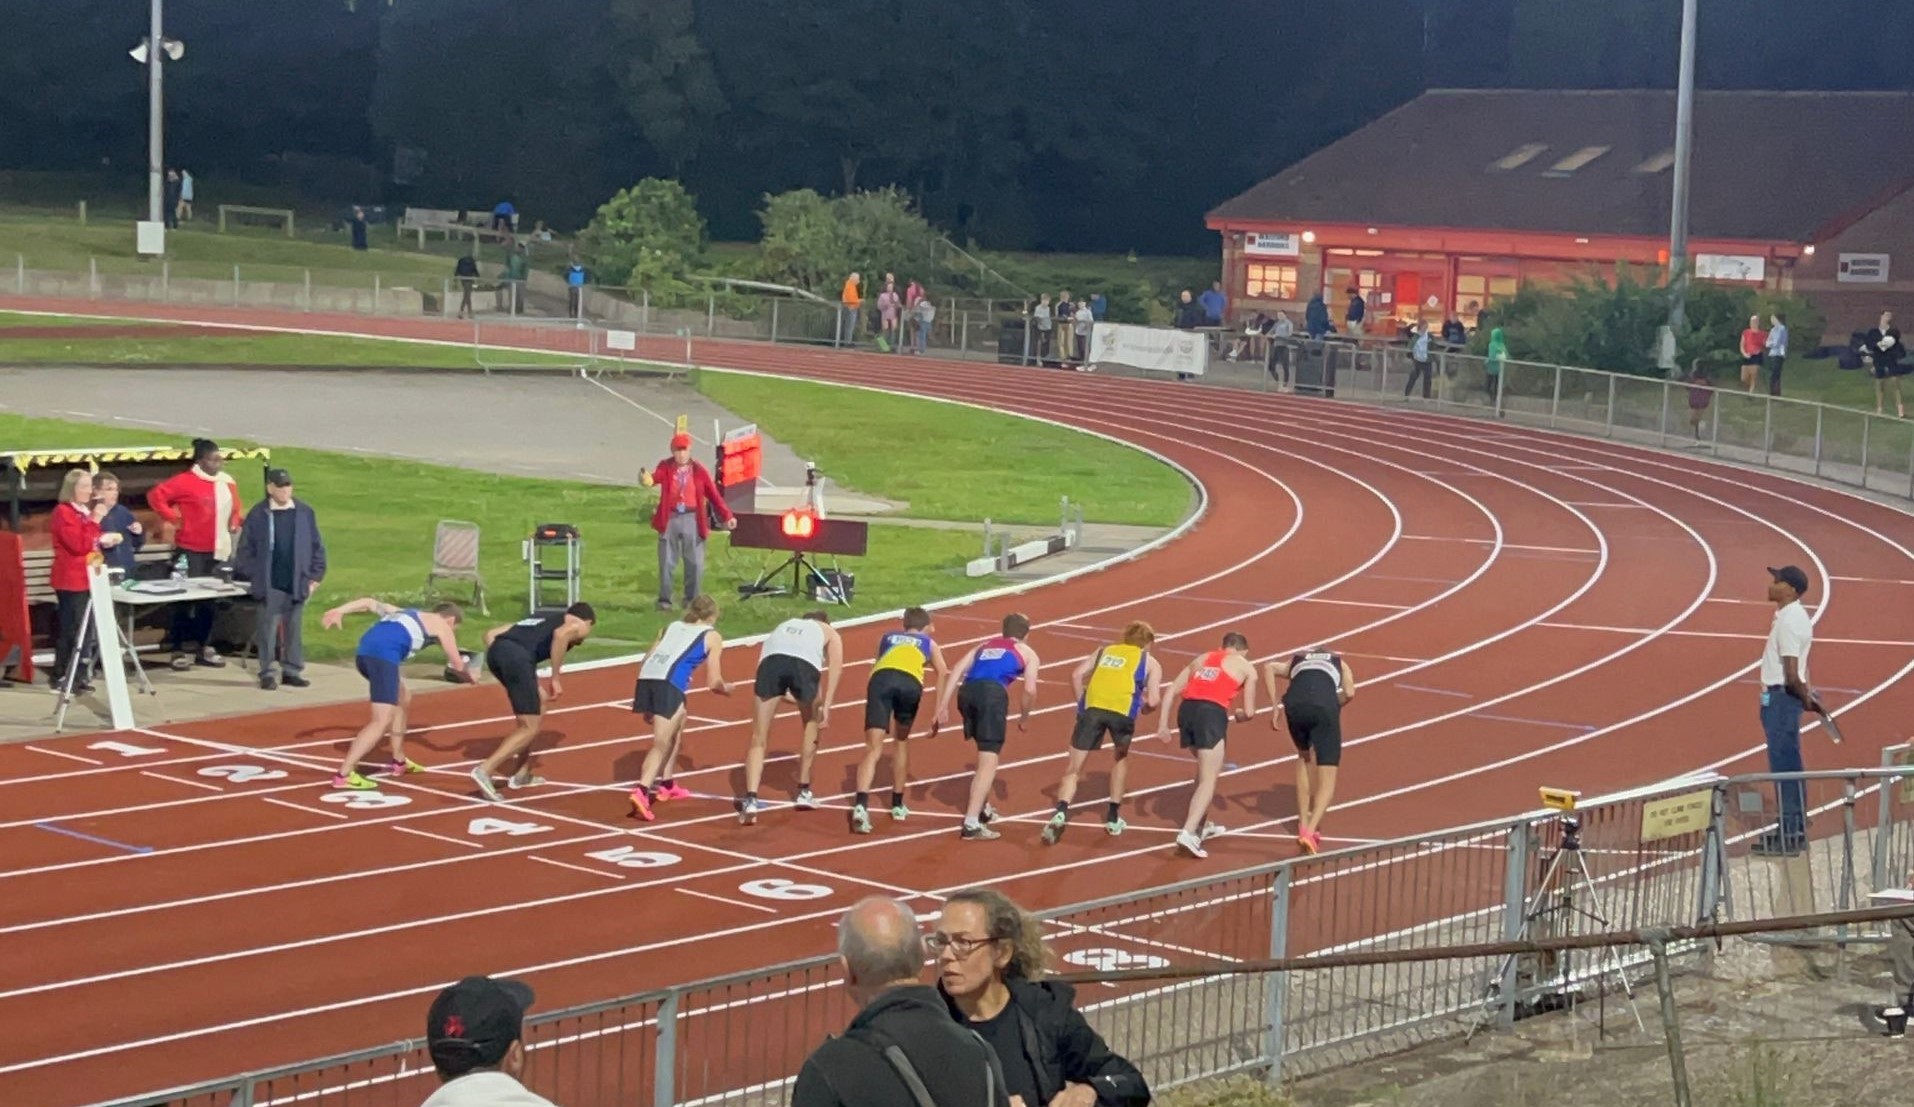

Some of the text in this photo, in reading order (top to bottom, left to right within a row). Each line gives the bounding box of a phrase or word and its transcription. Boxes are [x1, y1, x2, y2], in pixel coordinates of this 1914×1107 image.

[87, 741, 168, 757] 1
[197, 765, 288, 782] 2
[319, 790, 412, 809] 3
[467, 818, 554, 835] 4
[584, 846, 682, 868] 5
[738, 878, 834, 900] 6
